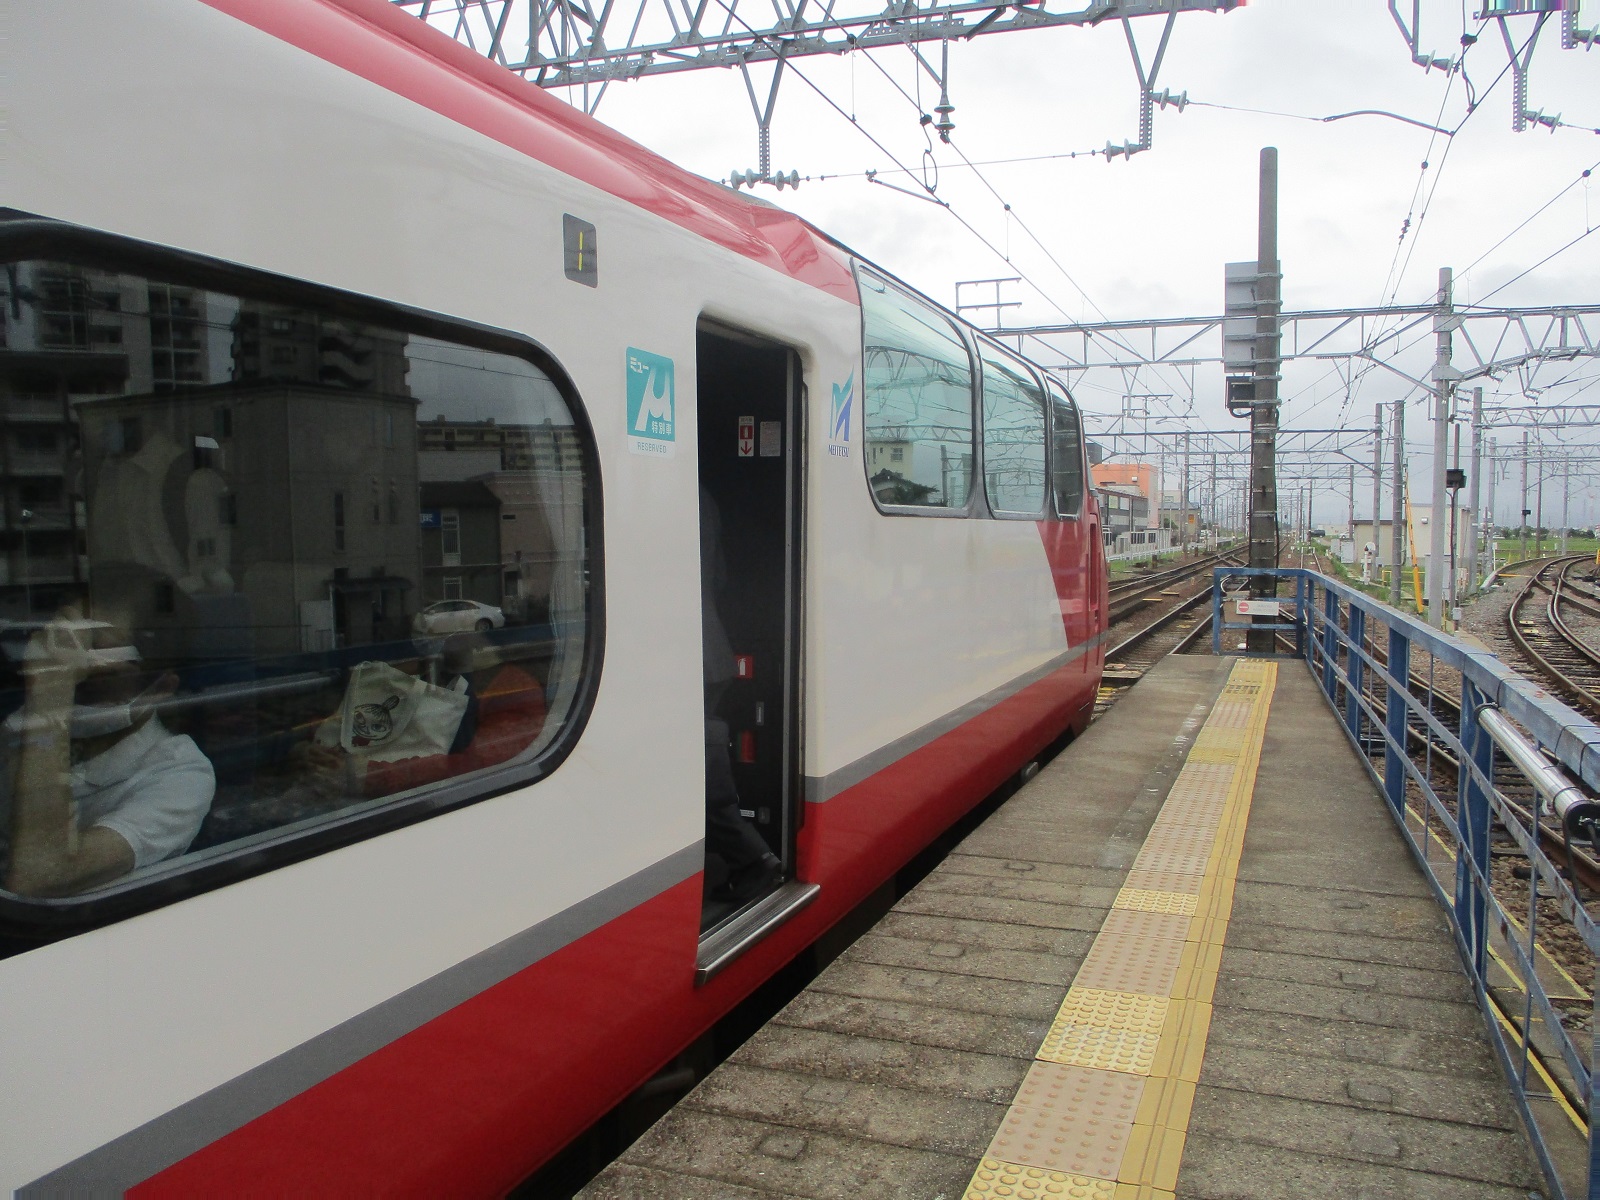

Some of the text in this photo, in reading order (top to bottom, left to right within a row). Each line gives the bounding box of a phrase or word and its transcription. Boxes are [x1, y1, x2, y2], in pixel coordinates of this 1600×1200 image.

[651, 420, 672, 435] 特別車
[637, 441, 667, 454] RESERVED
